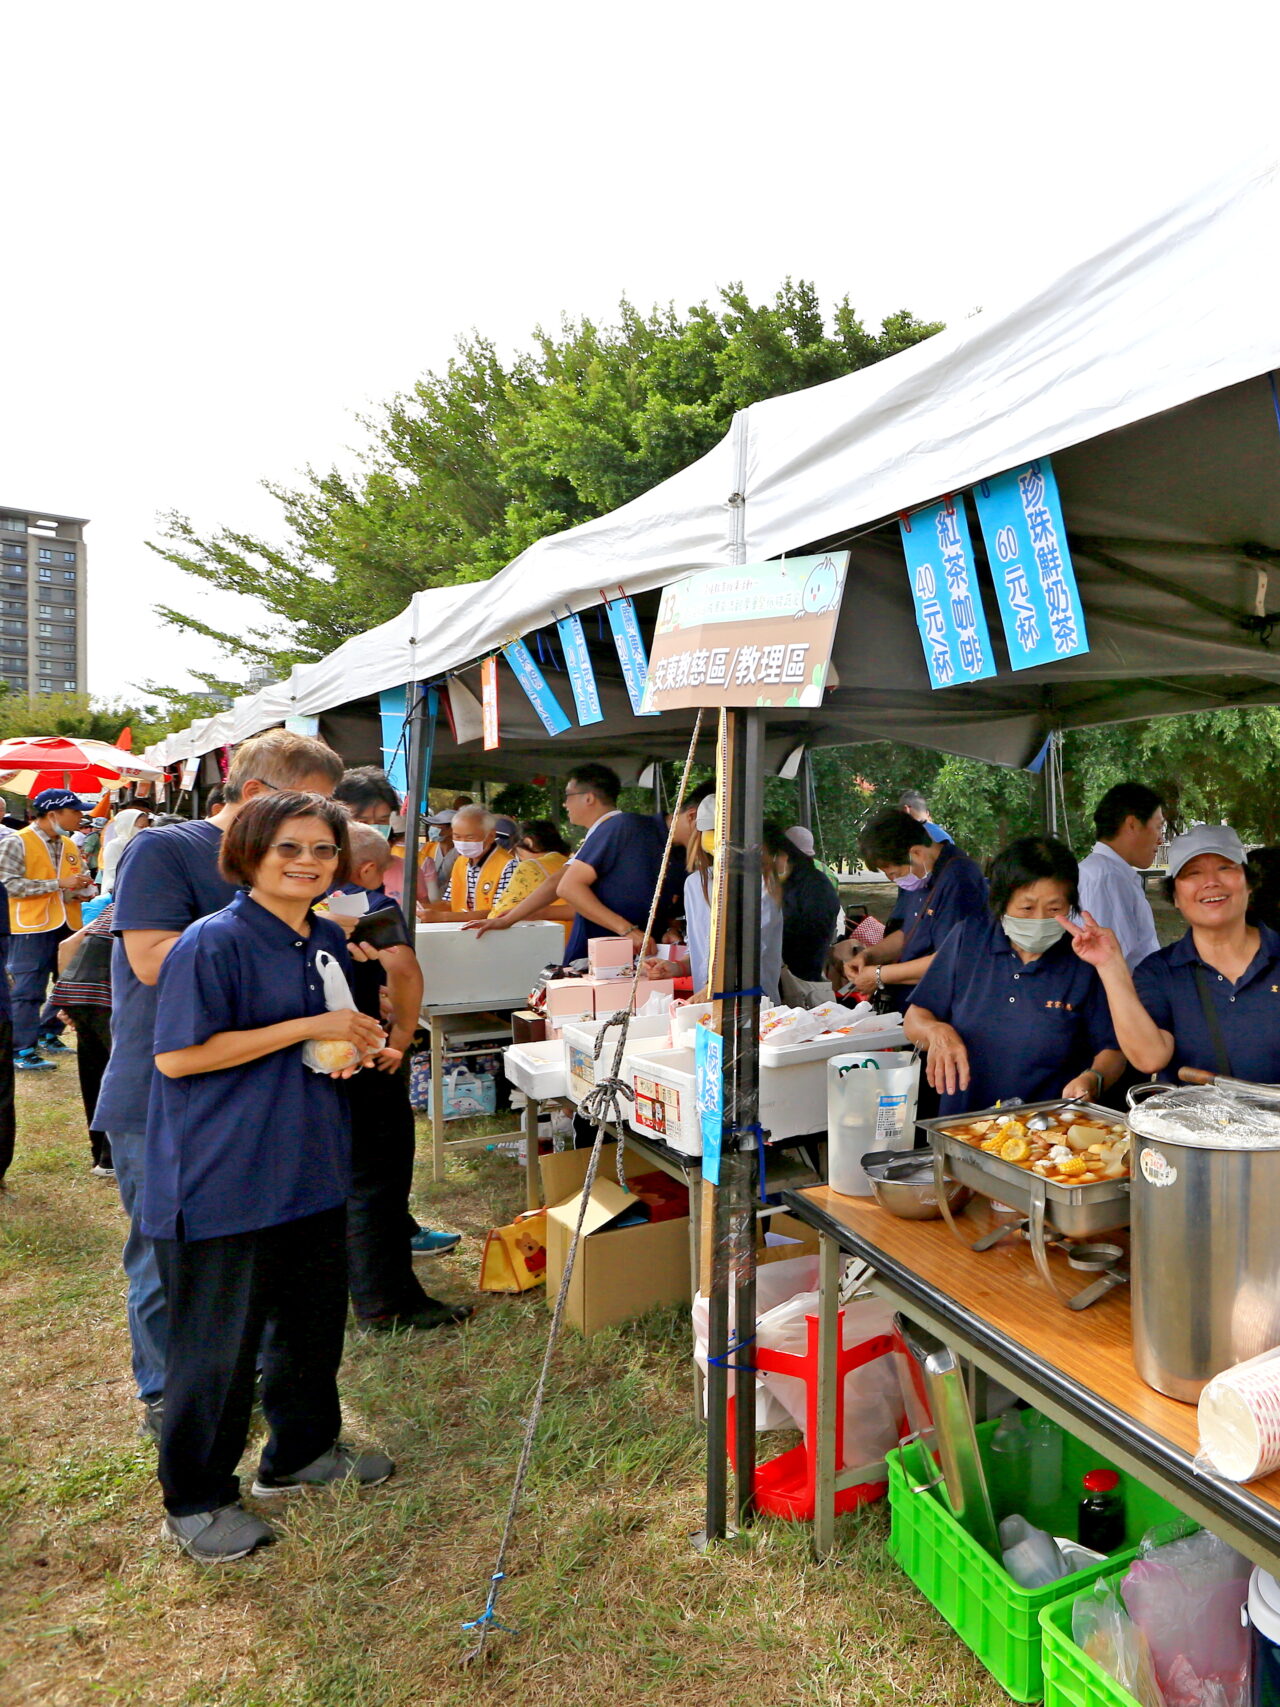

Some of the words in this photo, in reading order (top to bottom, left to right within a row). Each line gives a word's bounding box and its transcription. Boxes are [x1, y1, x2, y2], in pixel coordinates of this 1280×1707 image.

[916, 566, 954, 682] 40元/杯
[938, 513, 984, 672] 紅茶咖啡
[997, 527, 1040, 650] 60元/杯
[1019, 472, 1077, 653] 珍珠鮮奶茶
